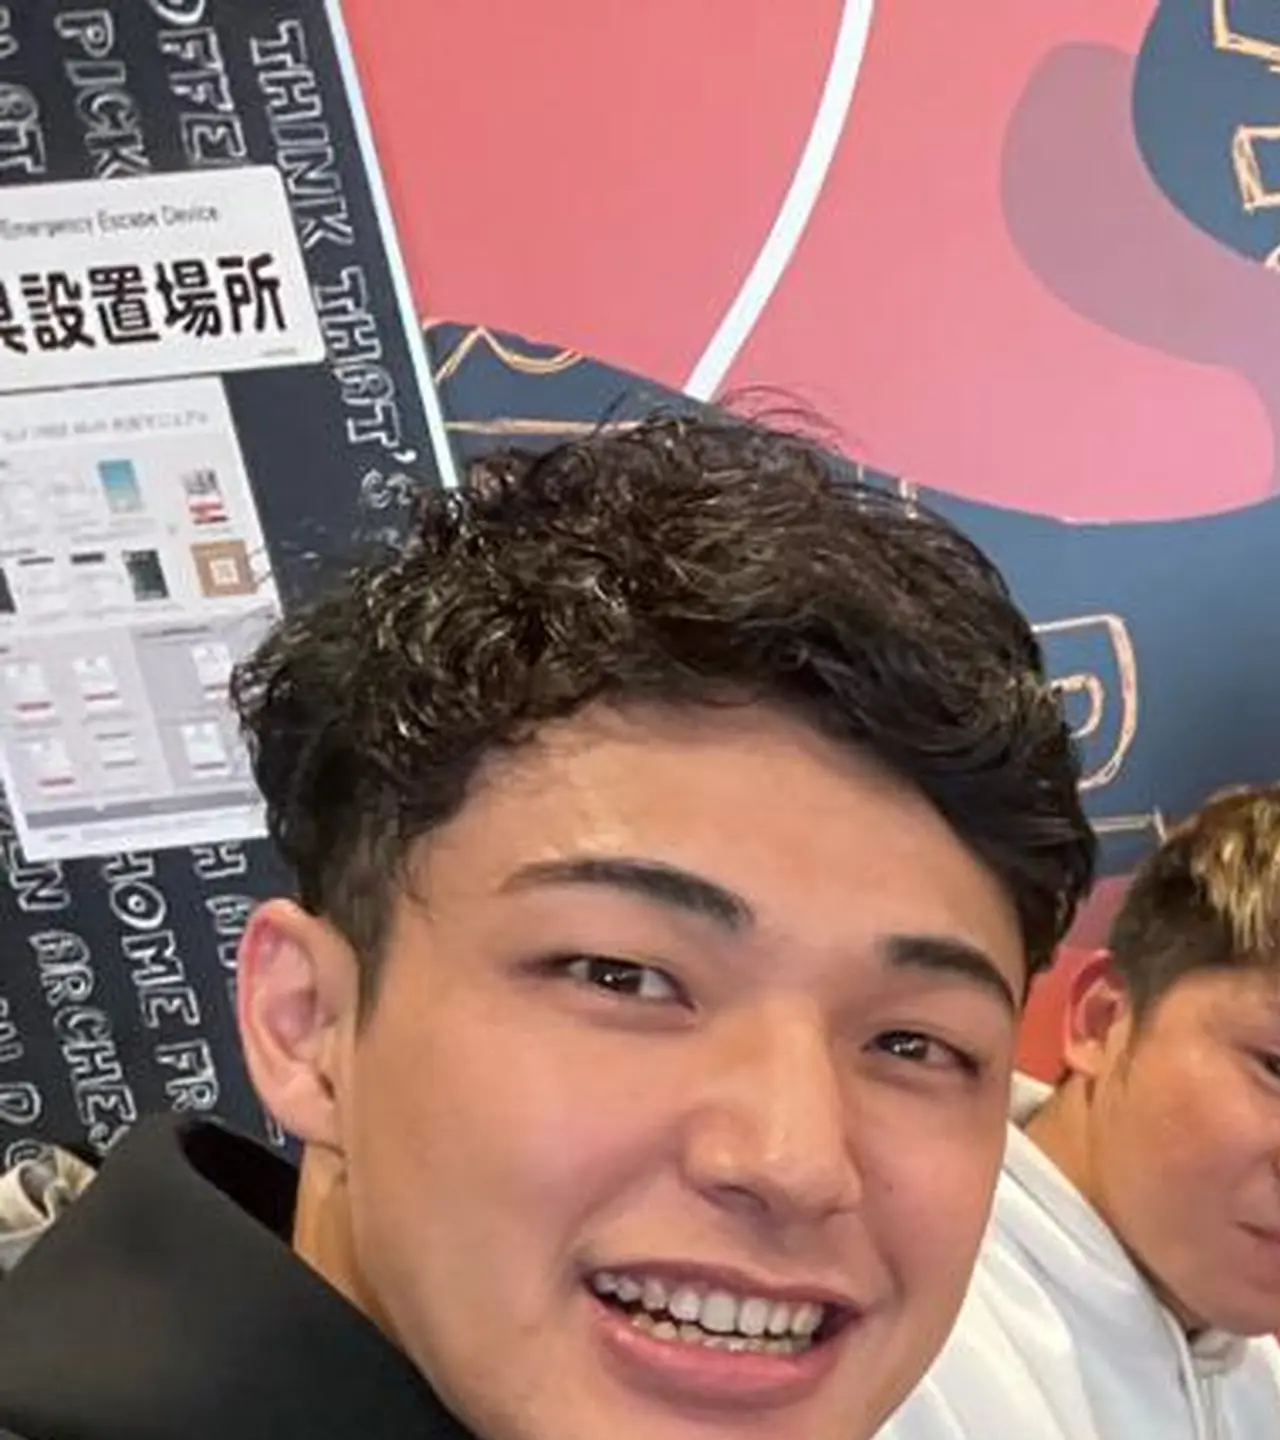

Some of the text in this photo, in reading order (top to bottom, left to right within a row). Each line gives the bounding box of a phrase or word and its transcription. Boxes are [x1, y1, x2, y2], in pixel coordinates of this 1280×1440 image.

[53, 9, 150, 180] PICK
[250, 19, 354, 250] THINK
[98, 208, 158, 233] Escape
[161, 204, 219, 225] Device
